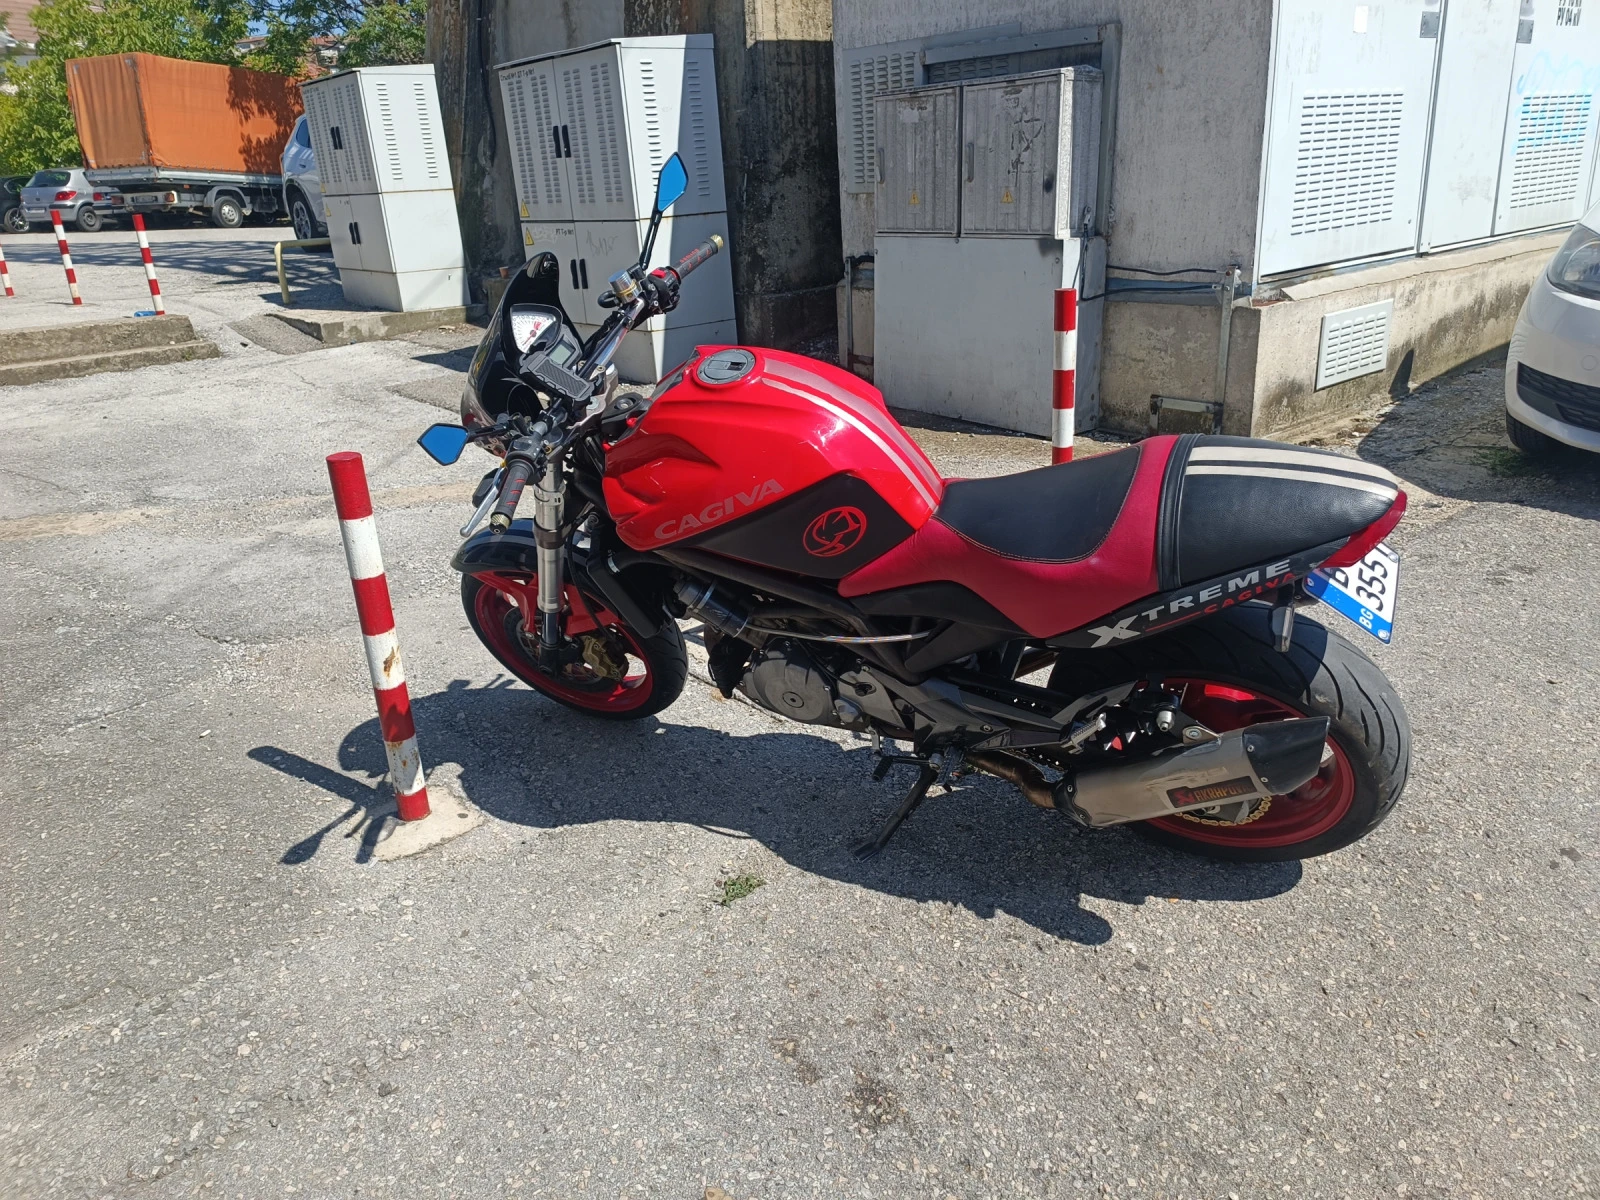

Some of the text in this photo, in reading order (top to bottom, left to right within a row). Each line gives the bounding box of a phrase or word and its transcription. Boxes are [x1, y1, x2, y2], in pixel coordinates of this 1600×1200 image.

[654, 479, 784, 539] CAGIVA
[1088, 559, 1290, 648] XTREME
[1204, 572, 1296, 613] CAGIVA
[1359, 608, 1374, 629] BG
